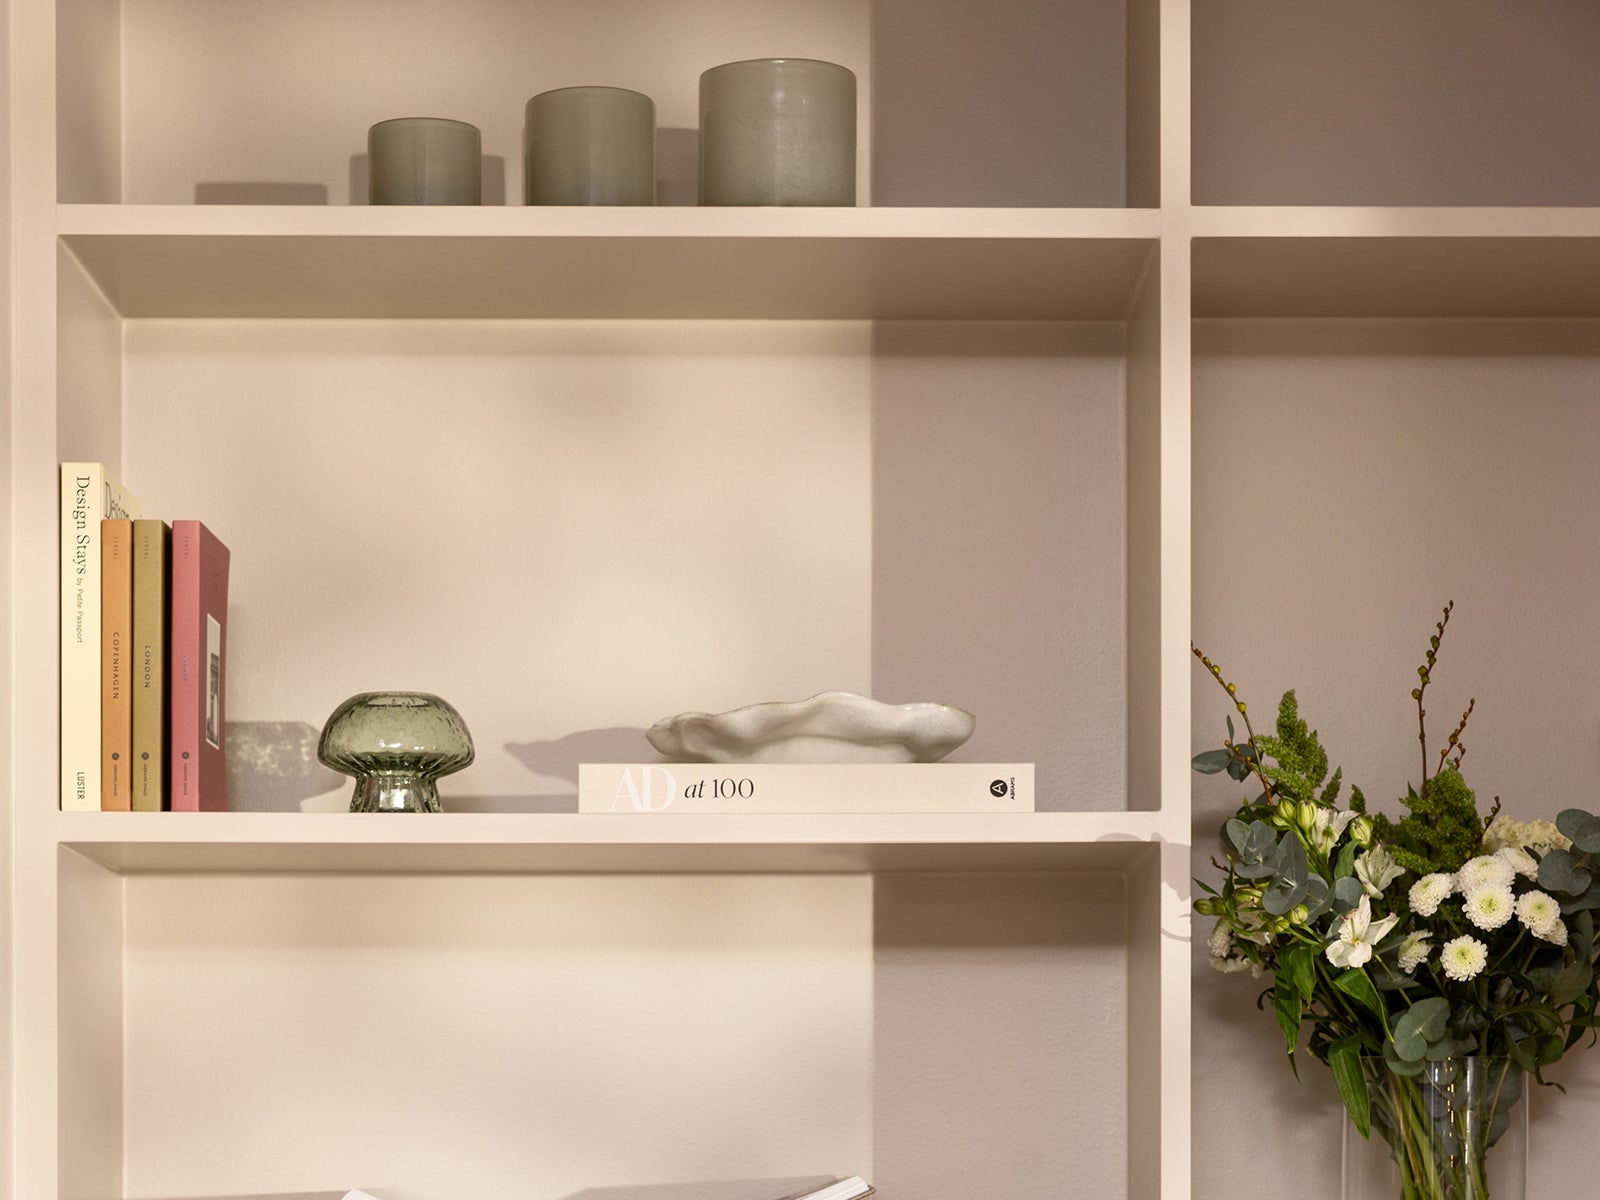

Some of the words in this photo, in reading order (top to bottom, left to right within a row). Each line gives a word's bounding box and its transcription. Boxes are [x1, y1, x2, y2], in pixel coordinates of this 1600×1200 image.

[72, 476, 91, 530] Design
[72, 534, 91, 575] Stays
[75, 578, 84, 587] by
[76, 611, 84, 644] Passport
[112, 631, 120, 699] COPENHAGEN
[76, 771, 85, 800] LUSTER
[607, 766, 677, 812] AD
[684, 779, 706, 799] at
[712, 778, 755, 799] 100
